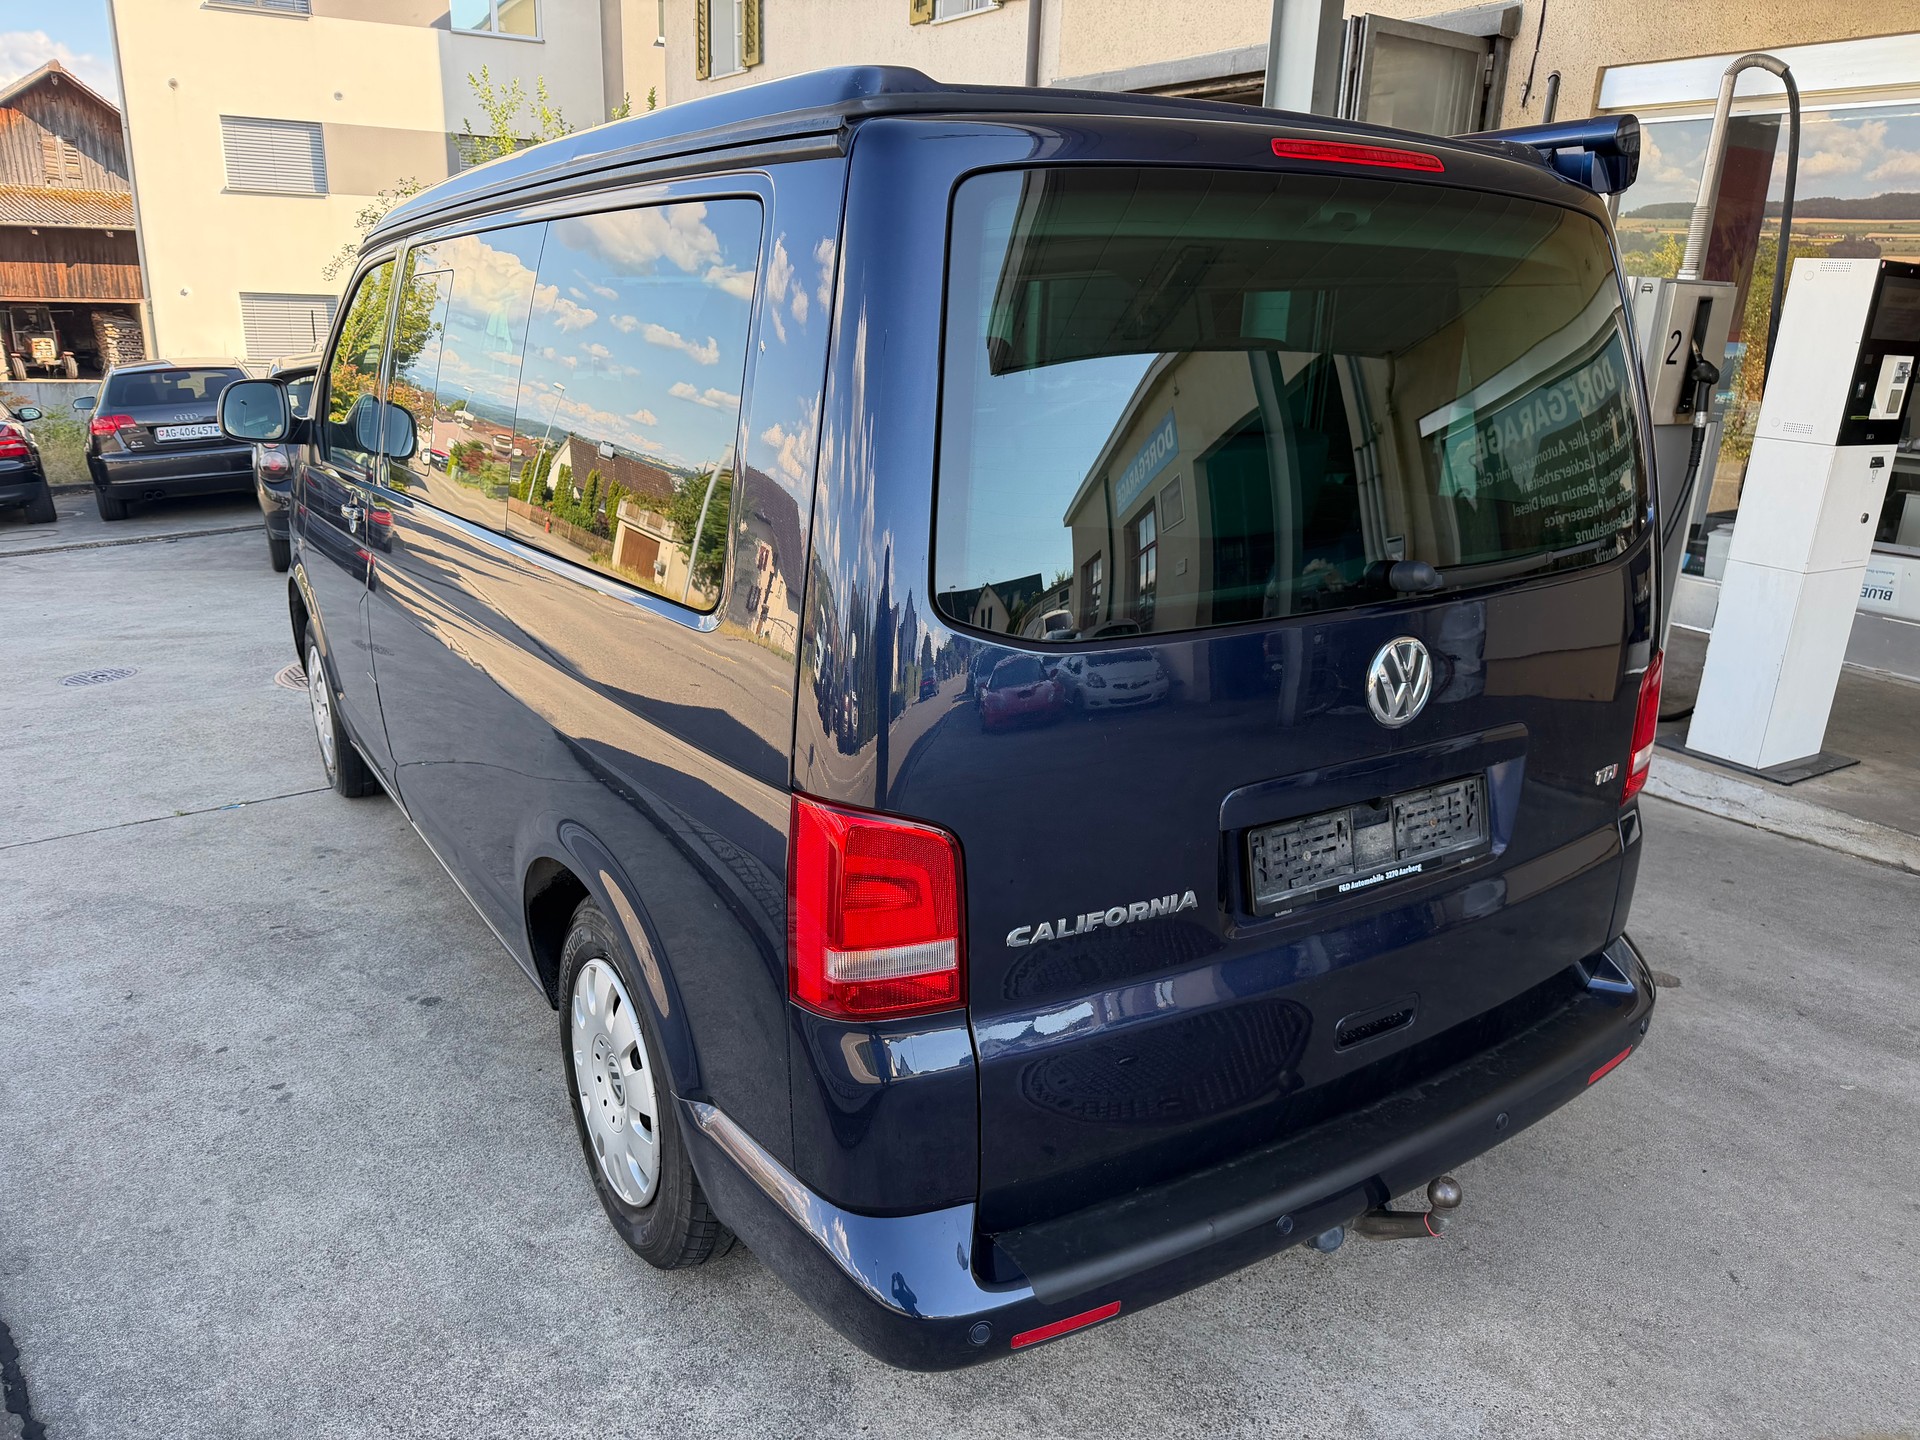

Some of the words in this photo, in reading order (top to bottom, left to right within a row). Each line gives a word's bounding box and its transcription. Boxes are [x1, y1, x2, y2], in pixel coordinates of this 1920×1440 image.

[1665, 329, 1682, 365] 2
[1860, 587, 1894, 601] BLUE
[1594, 763, 1618, 786] TDI
[1350, 874, 1385, 890] Automobile
[1385, 869, 1399, 880] 3270
[1399, 863, 1423, 877] Aarberg
[1006, 889, 1199, 948] CALIFORNIA
